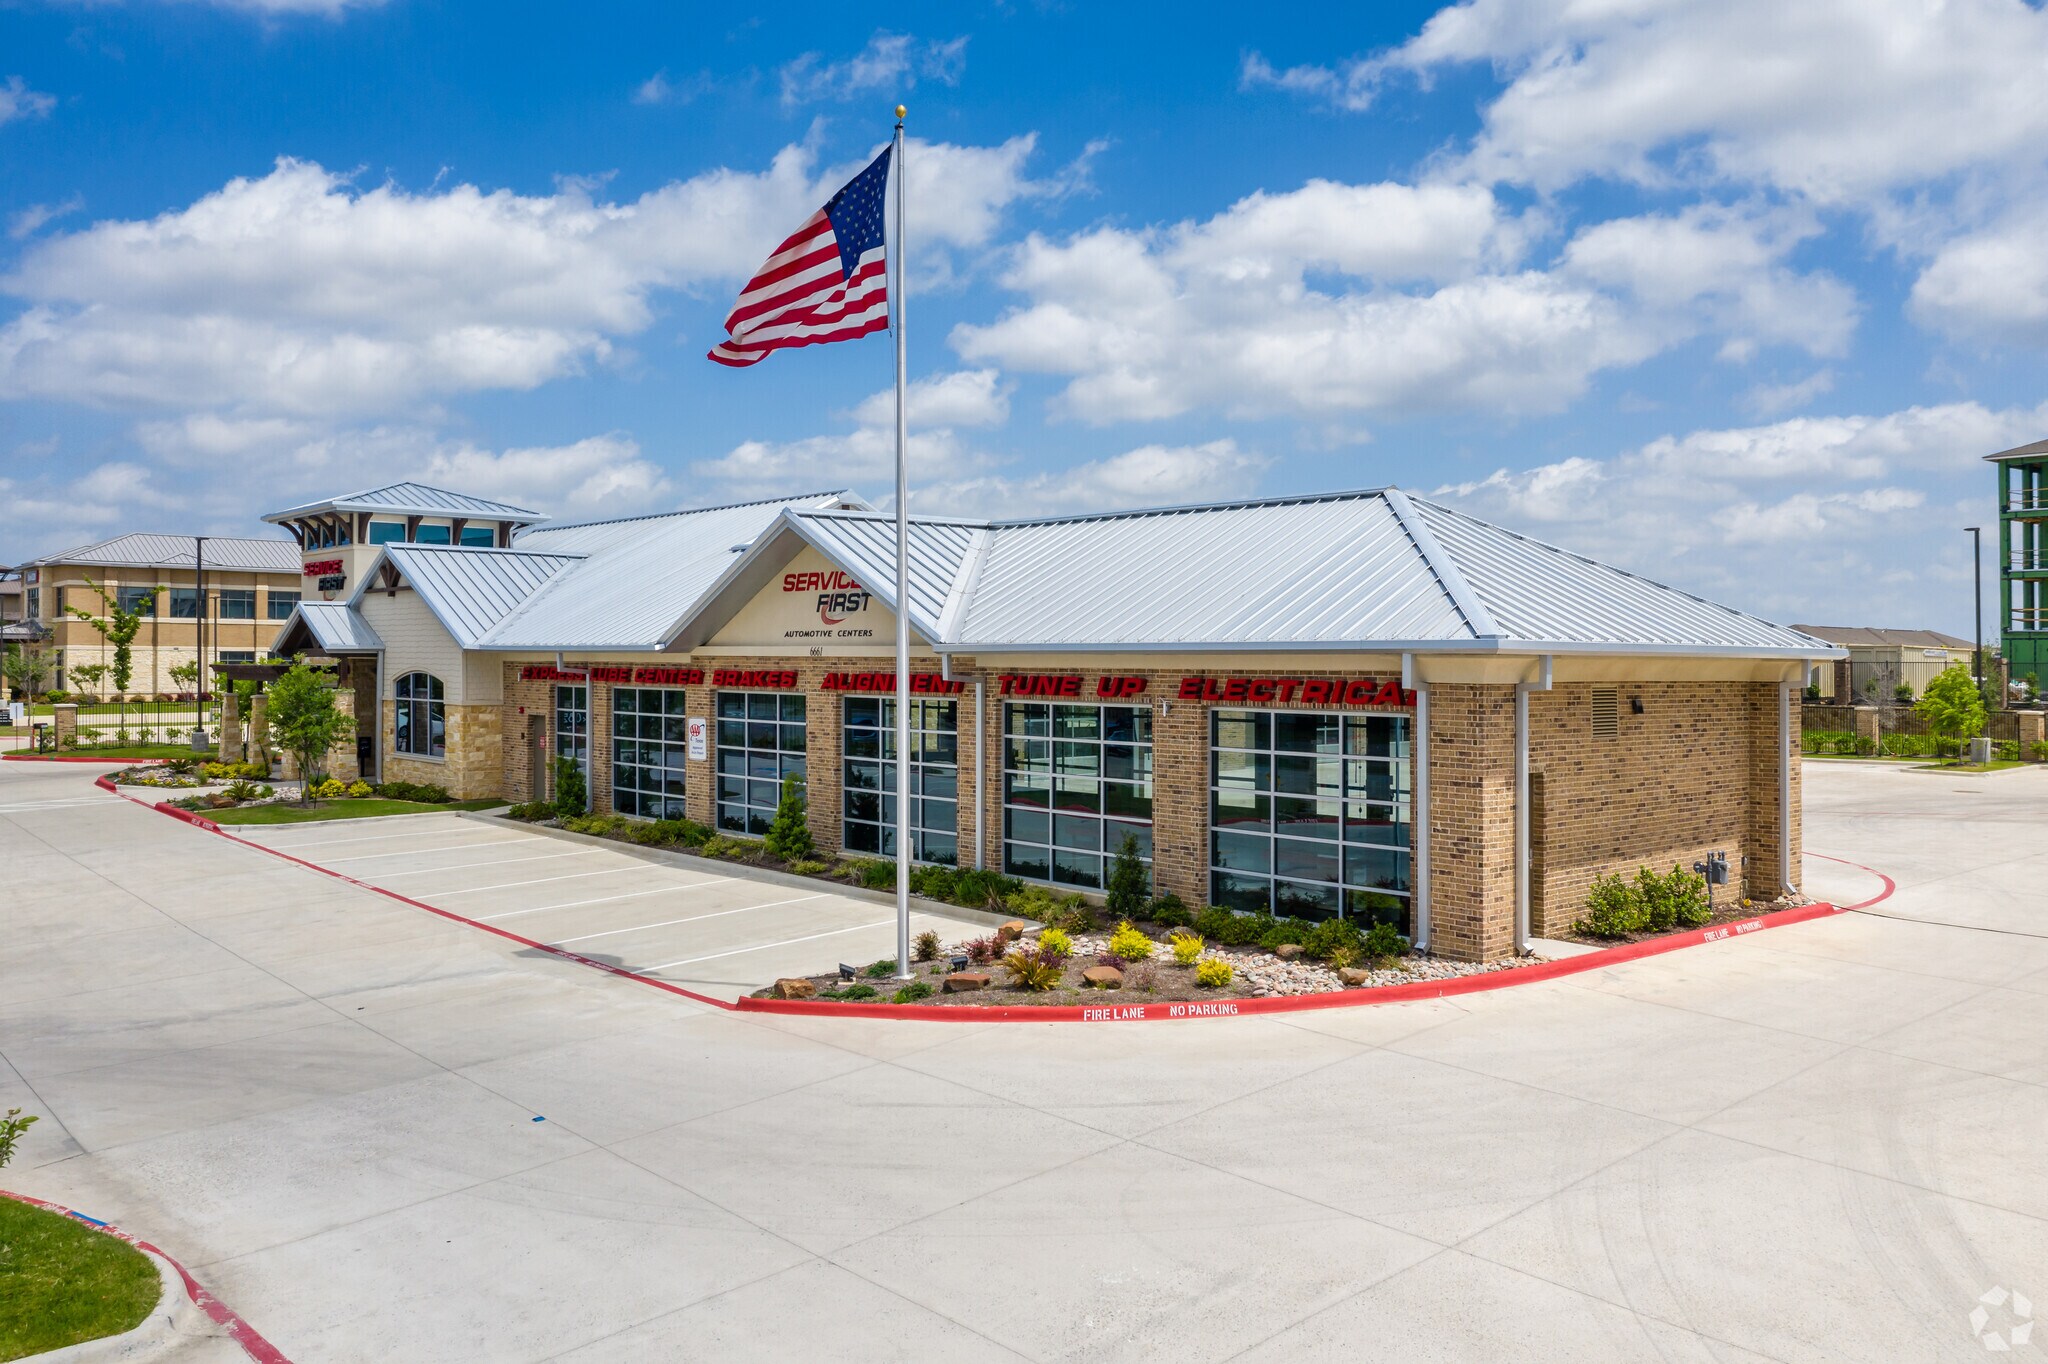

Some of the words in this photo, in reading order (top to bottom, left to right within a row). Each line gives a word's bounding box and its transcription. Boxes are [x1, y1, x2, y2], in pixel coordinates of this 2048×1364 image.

[816, 592, 873, 613] FIRST
[784, 630, 833, 638] AUTOMOTIVE
[837, 629, 873, 637] CENTERS
[809, 646, 823, 657] 6661
[590, 667, 633, 683] LUBE
[635, 668, 705, 685] CENTER
[712, 669, 798, 688] BRAKES
[998, 674, 1084, 697] TUNE
[1097, 676, 1148, 698] UP
[1083, 1009, 1111, 1021] FIRE
[1113, 1007, 1145, 1020] LANE
[1169, 1005, 1186, 1017] NO
[1188, 1003, 1238, 1016] PARKING
